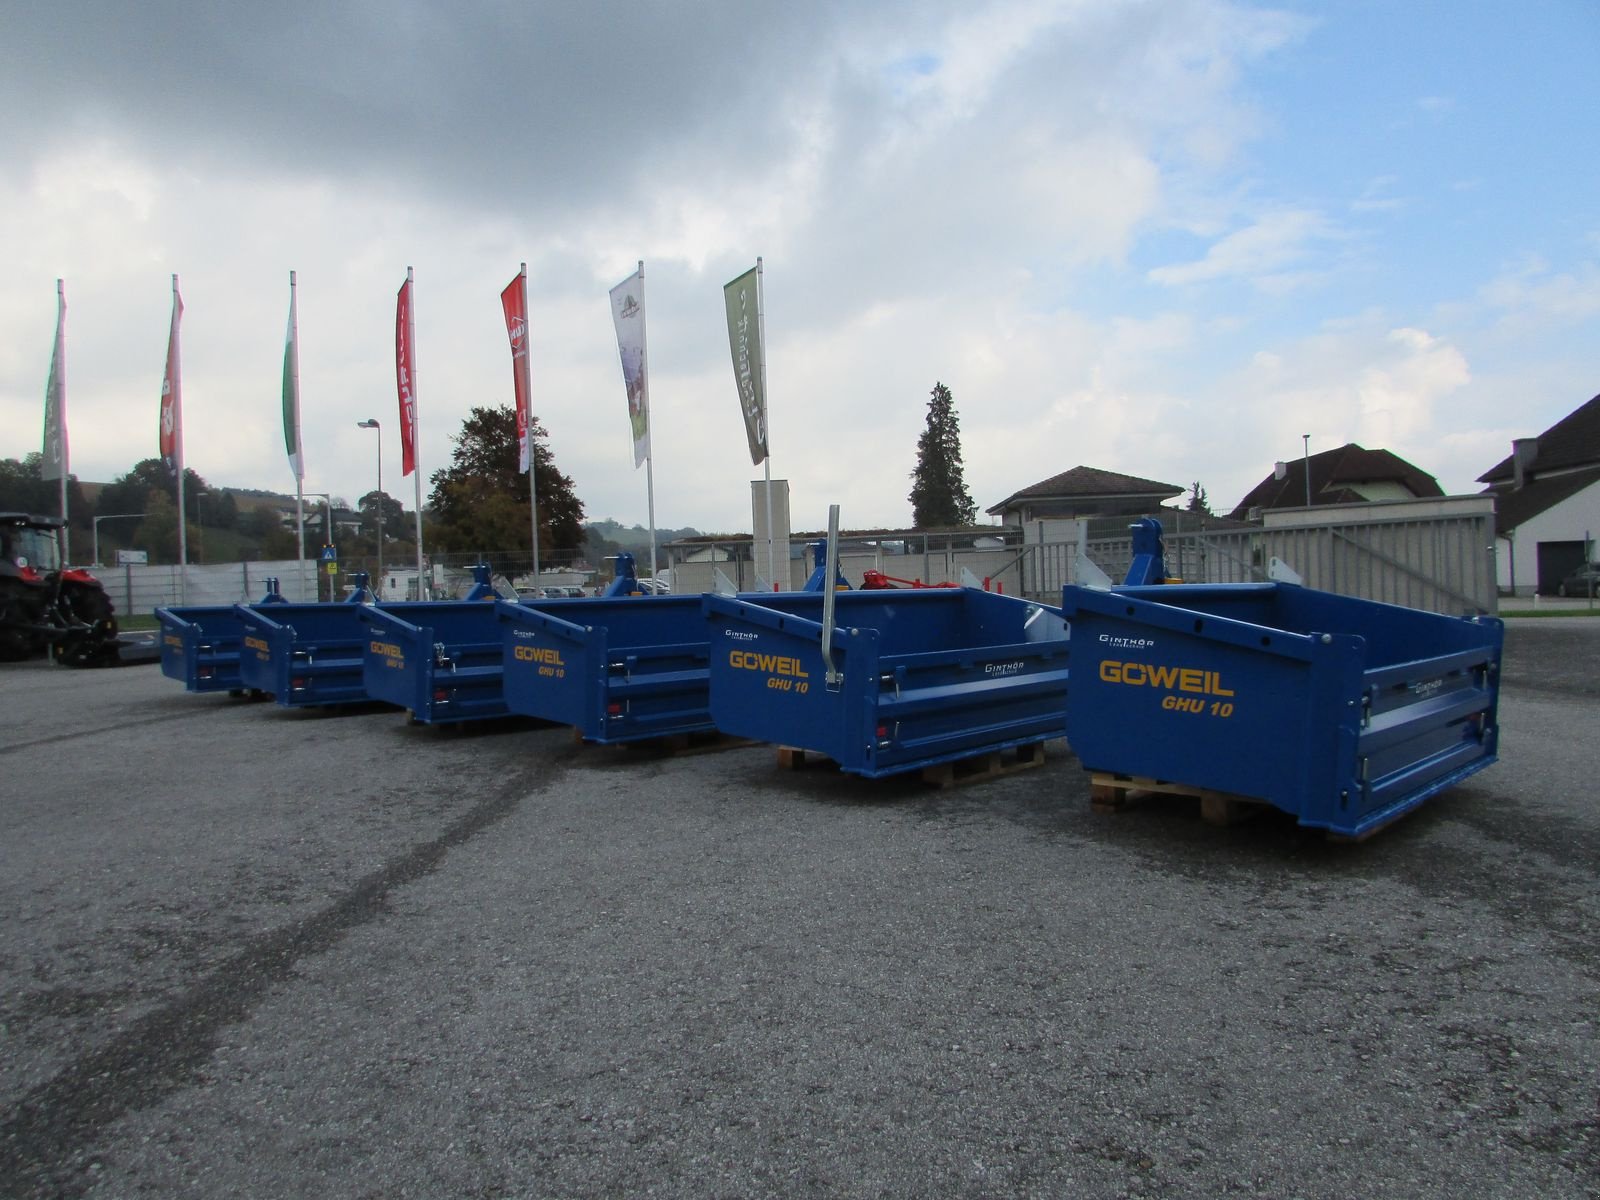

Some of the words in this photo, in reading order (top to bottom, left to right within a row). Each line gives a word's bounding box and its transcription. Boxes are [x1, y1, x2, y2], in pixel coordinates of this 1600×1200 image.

[767, 677, 792, 691] GHU
[794, 681, 809, 694] 10
[1161, 695, 1206, 714] GHU
[1210, 701, 1234, 718] 10
